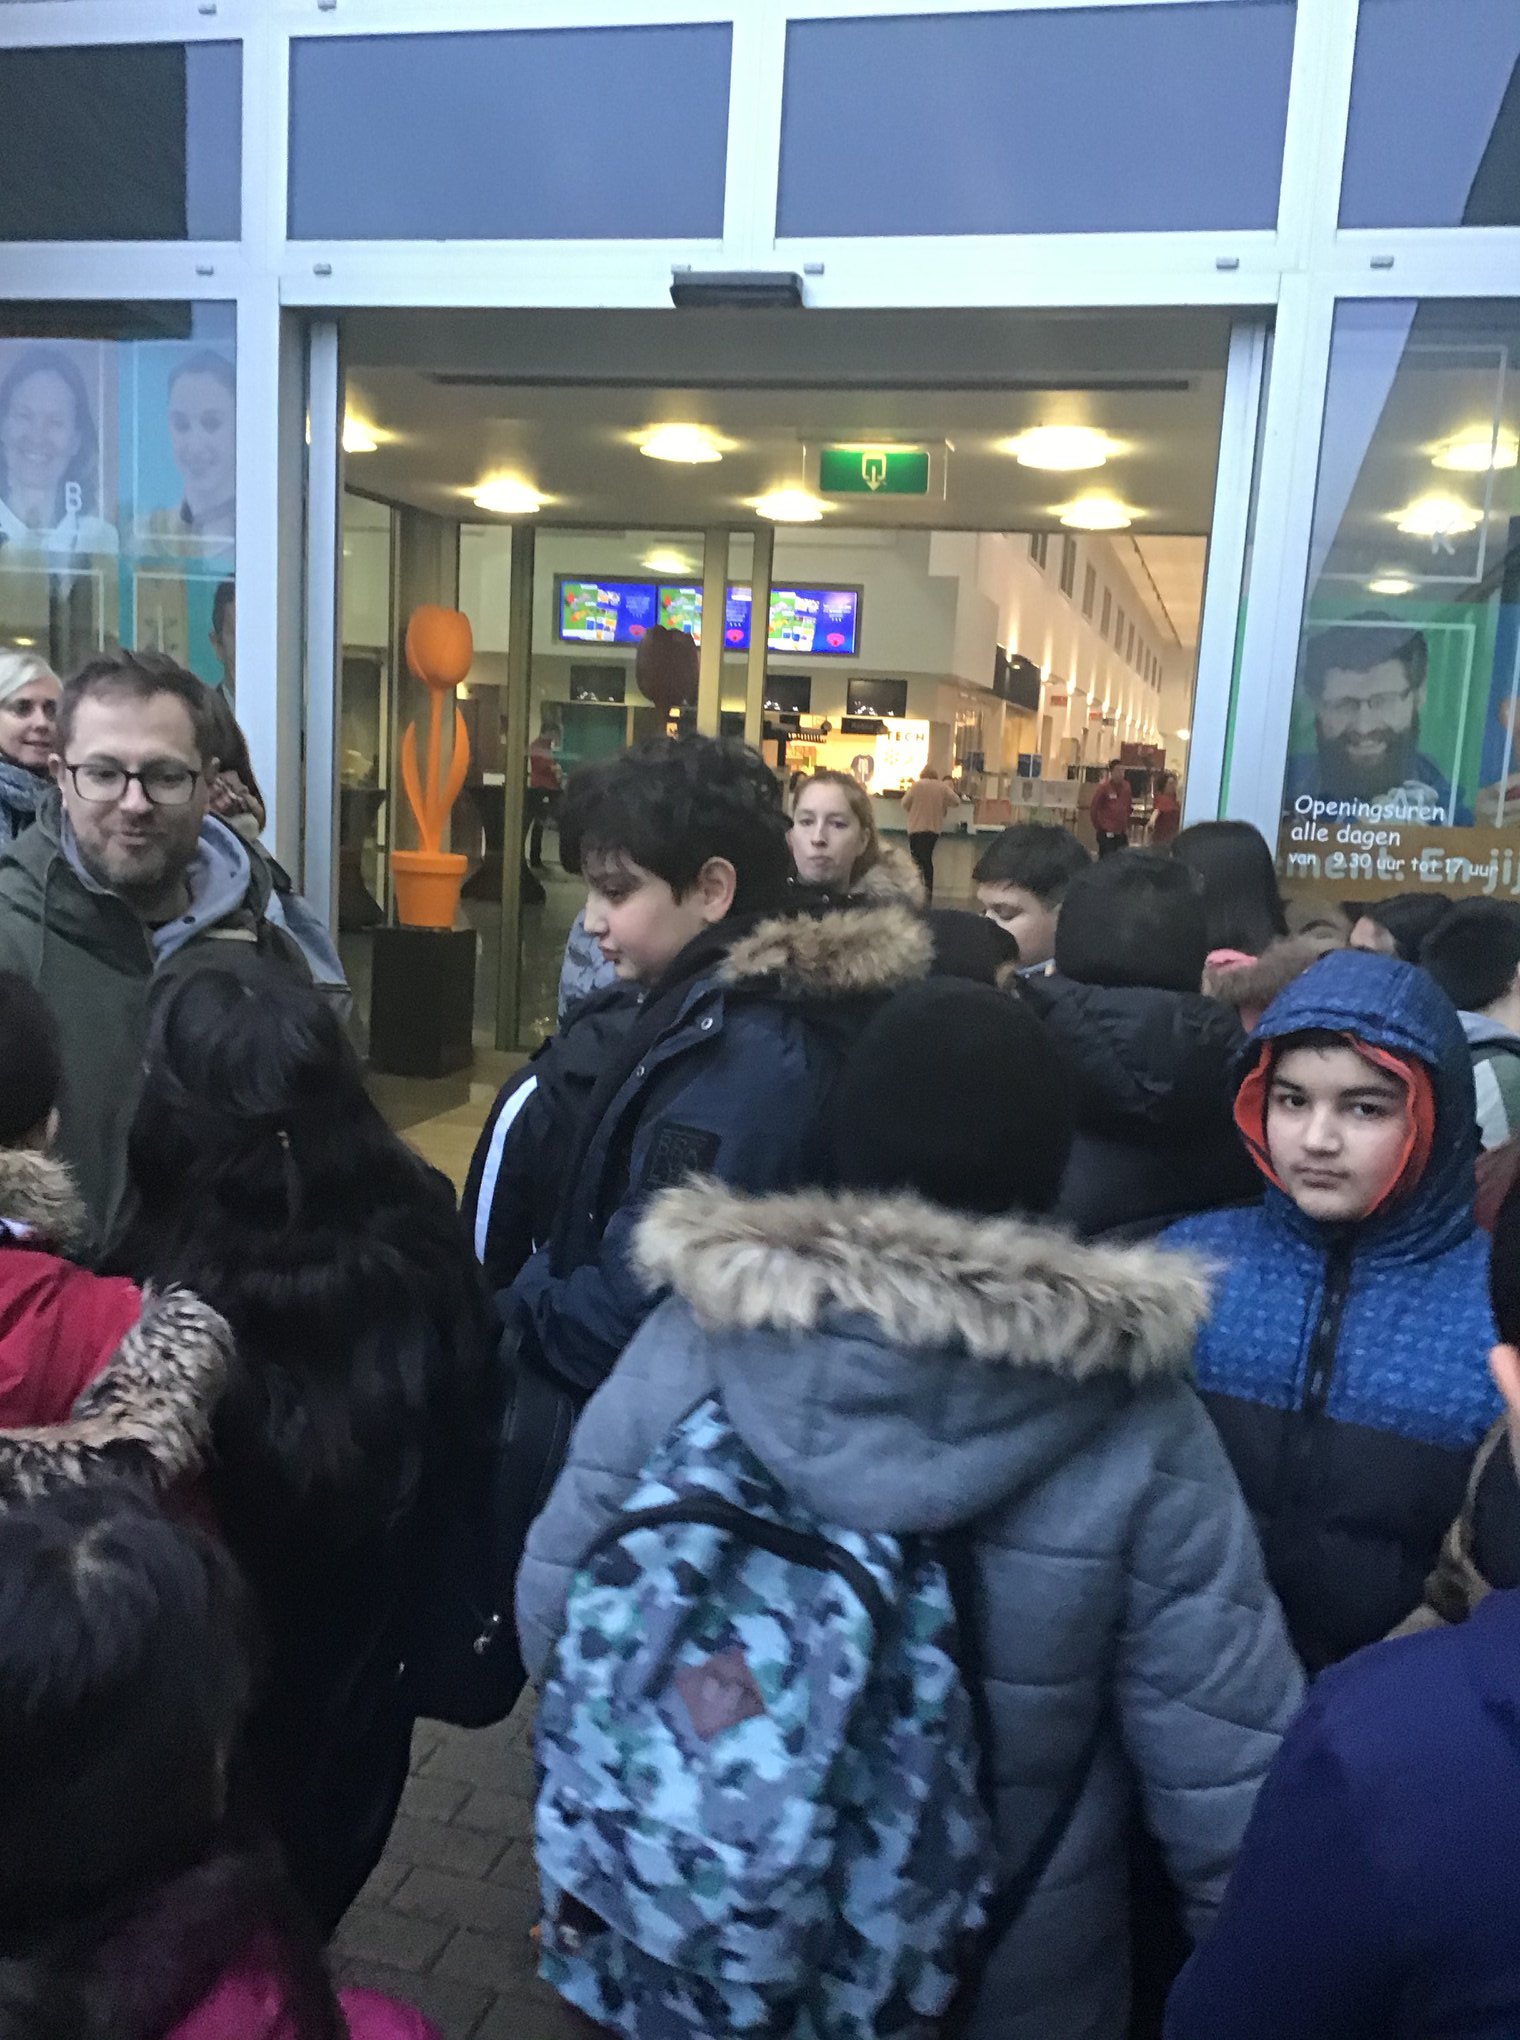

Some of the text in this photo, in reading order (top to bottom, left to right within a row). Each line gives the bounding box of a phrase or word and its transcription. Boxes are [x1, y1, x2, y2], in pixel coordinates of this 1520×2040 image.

[65, 480, 82, 512] B
[1295, 795, 1444, 823] Openingsuren
[1291, 821, 1401, 850] alle dagen
[1289, 851, 1498, 877] van 9.30 uur tot 17 uur
